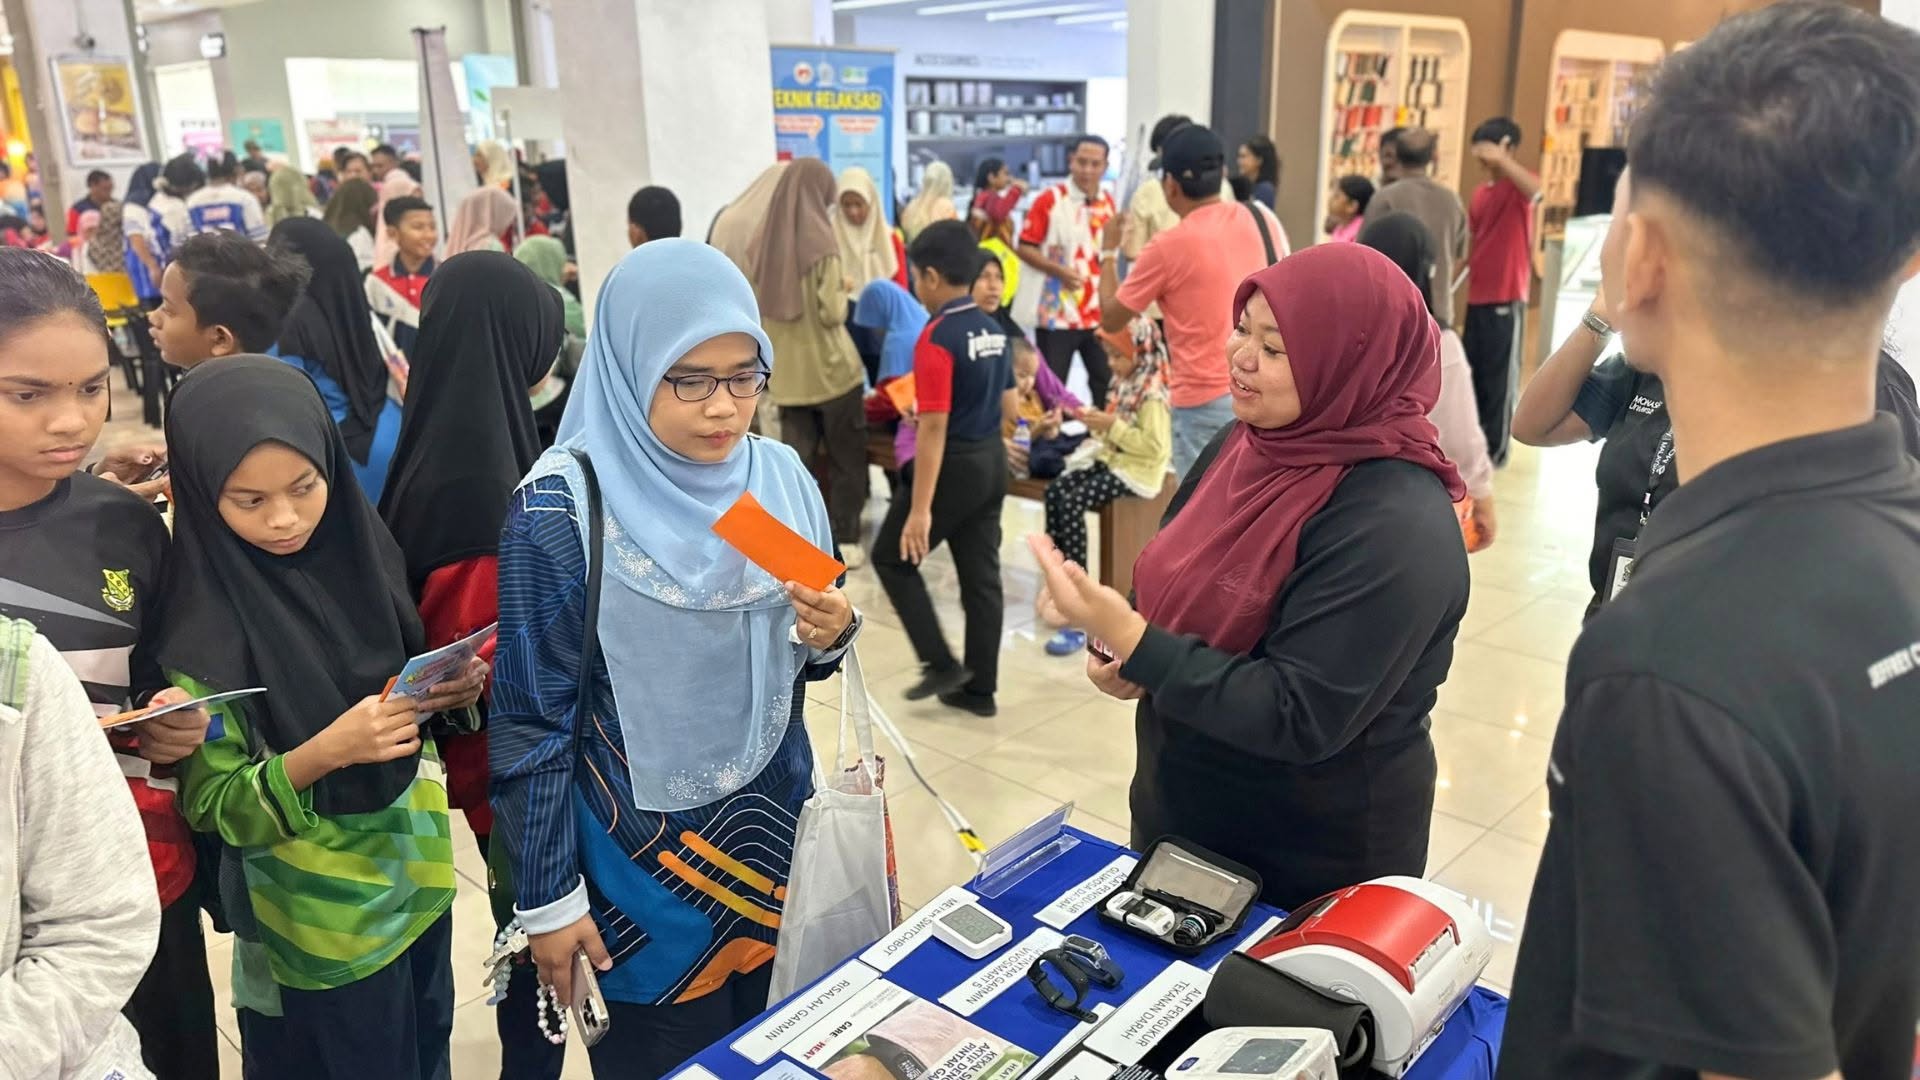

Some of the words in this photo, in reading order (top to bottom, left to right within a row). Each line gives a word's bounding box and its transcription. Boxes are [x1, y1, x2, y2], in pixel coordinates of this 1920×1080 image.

[1083, 866, 1120, 890] GLUKOSA
[1109, 872, 1127, 888] ALAT
[884, 917, 933, 956] SWITCHBOT
[980, 947, 1031, 984] VIVOSMART
[1003, 953, 1037, 978] PINTAR
[807, 979, 850, 1011] RISALAH
[966, 977, 1005, 1005] GARMIN
[972, 981, 983, 989] 5
[1149, 981, 1191, 1014] TEKANAN
[1179, 987, 1202, 1007] ALAT
[765, 1009, 809, 1041] GARMIN
[829, 1020, 853, 1038] CARE
[1120, 1011, 1155, 1040] DARAH
[1135, 1005, 1184, 1047] PENGUKUR
[803, 1041, 826, 1060] HEAT
[943, 1042, 977, 1069] PINTAR
[966, 1042, 991, 1064] AKTIF
[969, 1050, 998, 1072] KEKAL
[1001, 1063, 1018, 1080] HEAT
